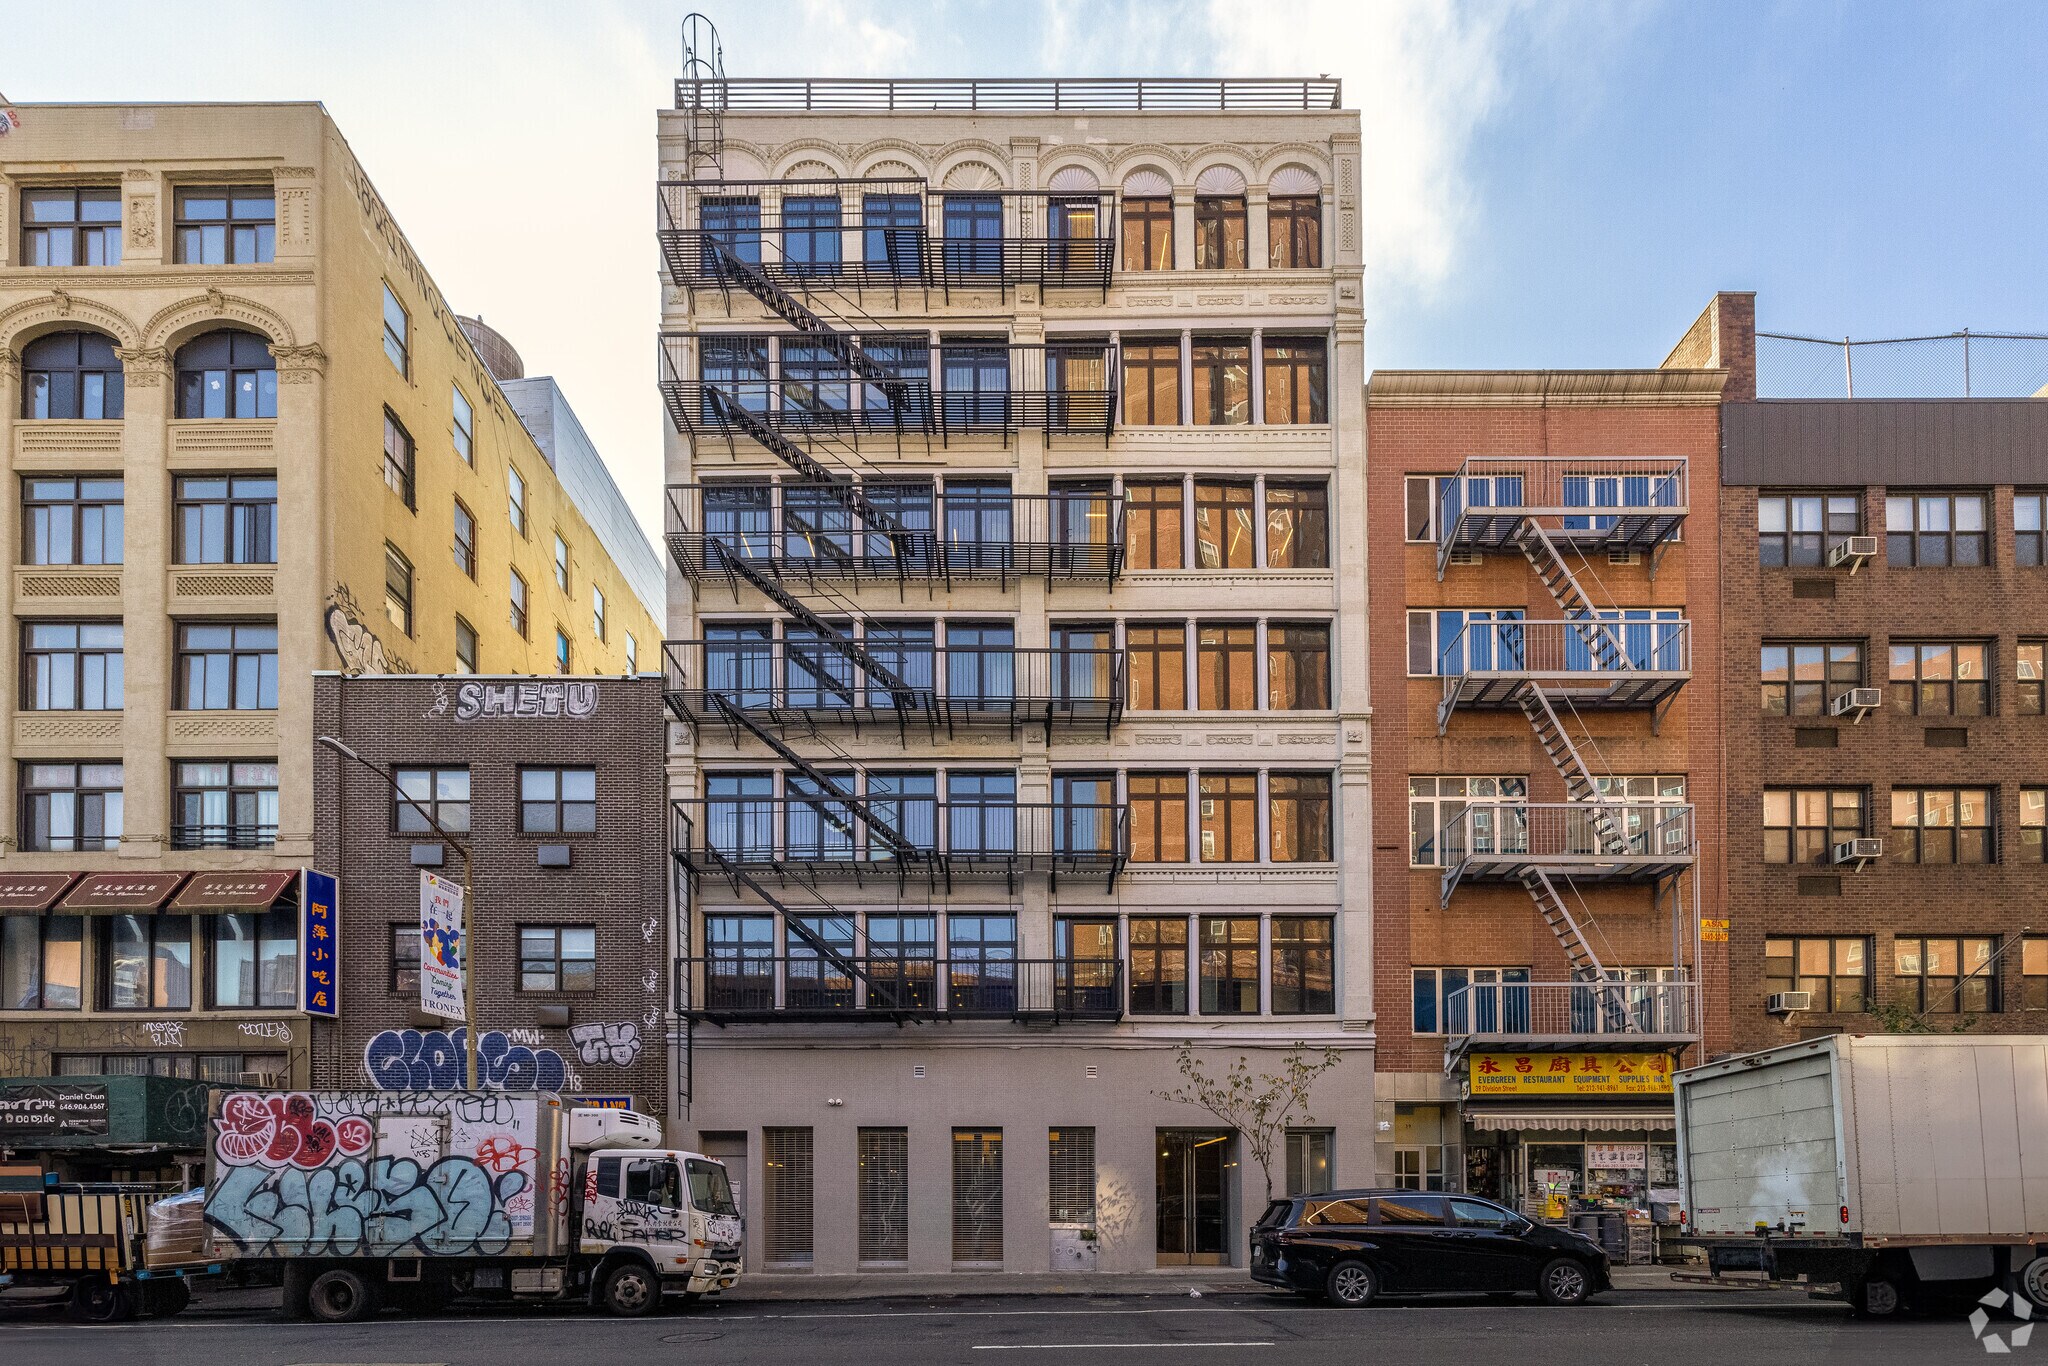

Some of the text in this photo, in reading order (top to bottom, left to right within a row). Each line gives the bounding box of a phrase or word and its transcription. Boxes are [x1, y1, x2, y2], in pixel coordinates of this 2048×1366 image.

[423, 962, 459, 980] Communities
[430, 972, 454, 991] Coming
[431, 986, 457, 1000] Together
[422, 998, 462, 1015] TRONEX
[1478, 1055, 1667, 1074] 永昌廚具公司
[1478, 1076, 1516, 1084] EVERGREEN
[1574, 1075, 1610, 1083] EQUIPMENT
[1619, 1075, 1650, 1083] SUPPLIES
